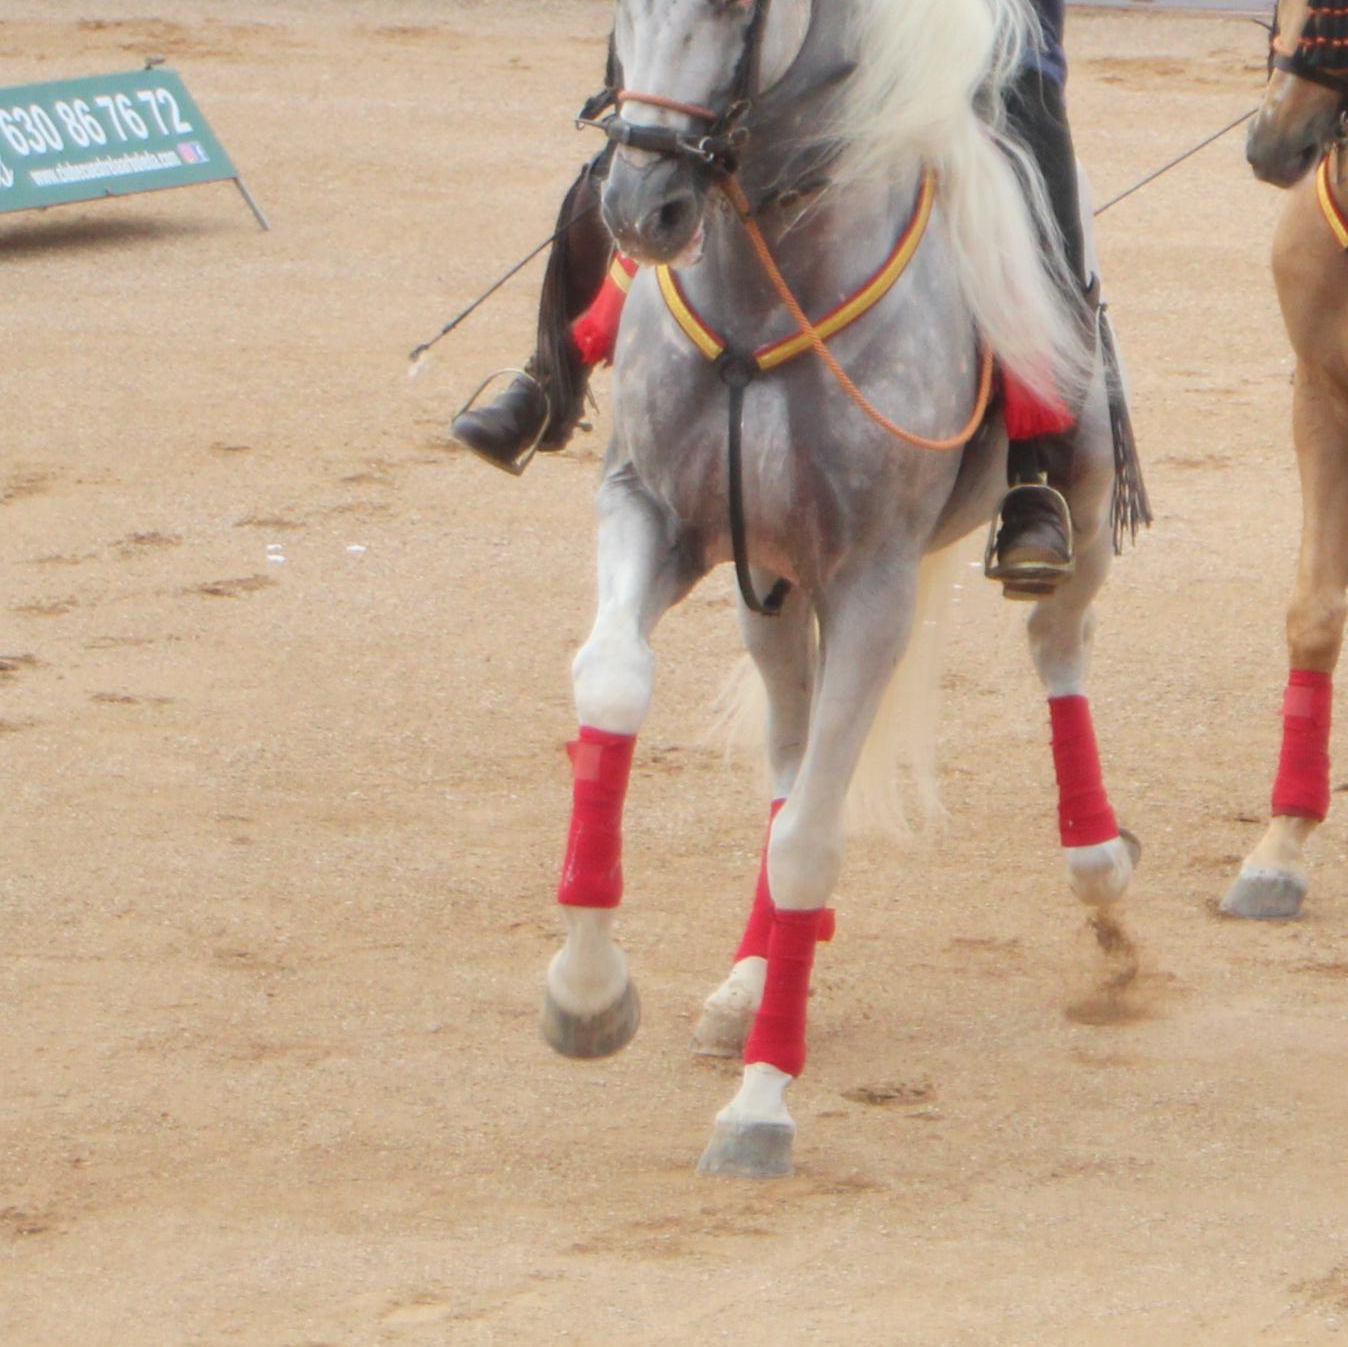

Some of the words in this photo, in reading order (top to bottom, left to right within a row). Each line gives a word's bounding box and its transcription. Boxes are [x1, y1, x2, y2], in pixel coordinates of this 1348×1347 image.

[0, 104, 64, 156] 630
[55, 98, 107, 148] 86
[94, 92, 149, 141] 76
[135, 87, 194, 136] 72
